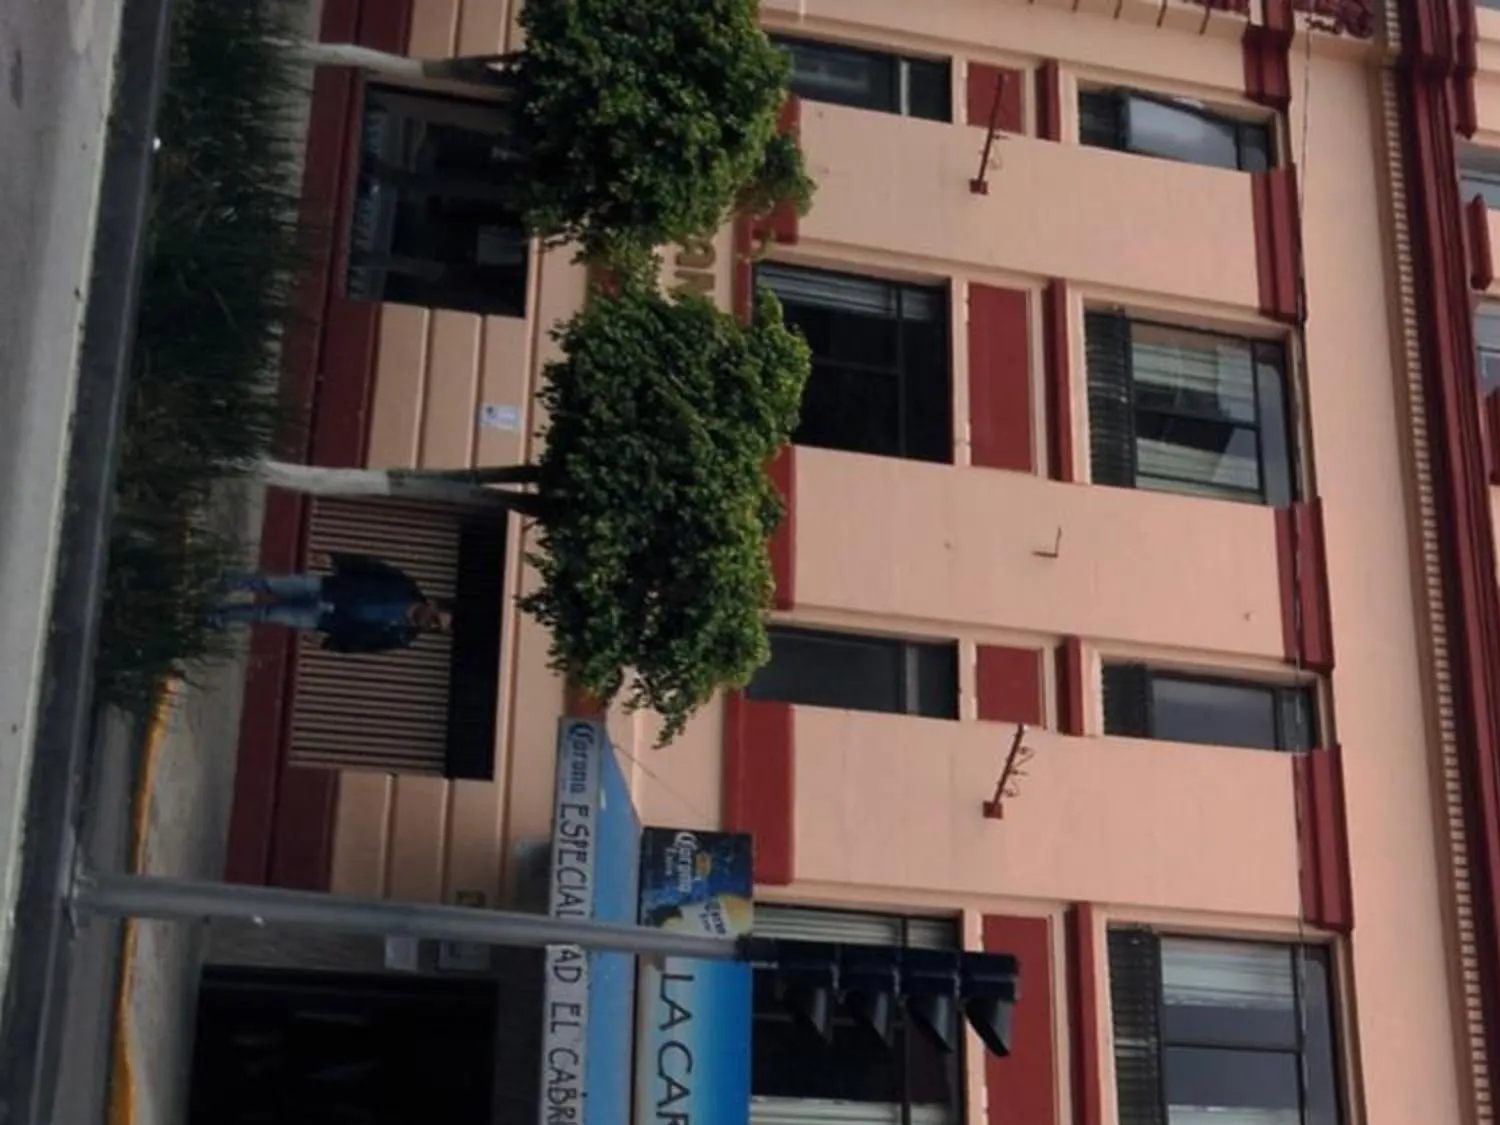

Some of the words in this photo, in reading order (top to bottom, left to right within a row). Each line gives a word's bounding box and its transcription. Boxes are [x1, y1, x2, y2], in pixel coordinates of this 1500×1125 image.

[568, 723, 595, 794] Corona
[550, 803, 590, 983] ESPECIALAD
[549, 1002, 582, 1035] EL
[659, 973, 695, 1031] LA
